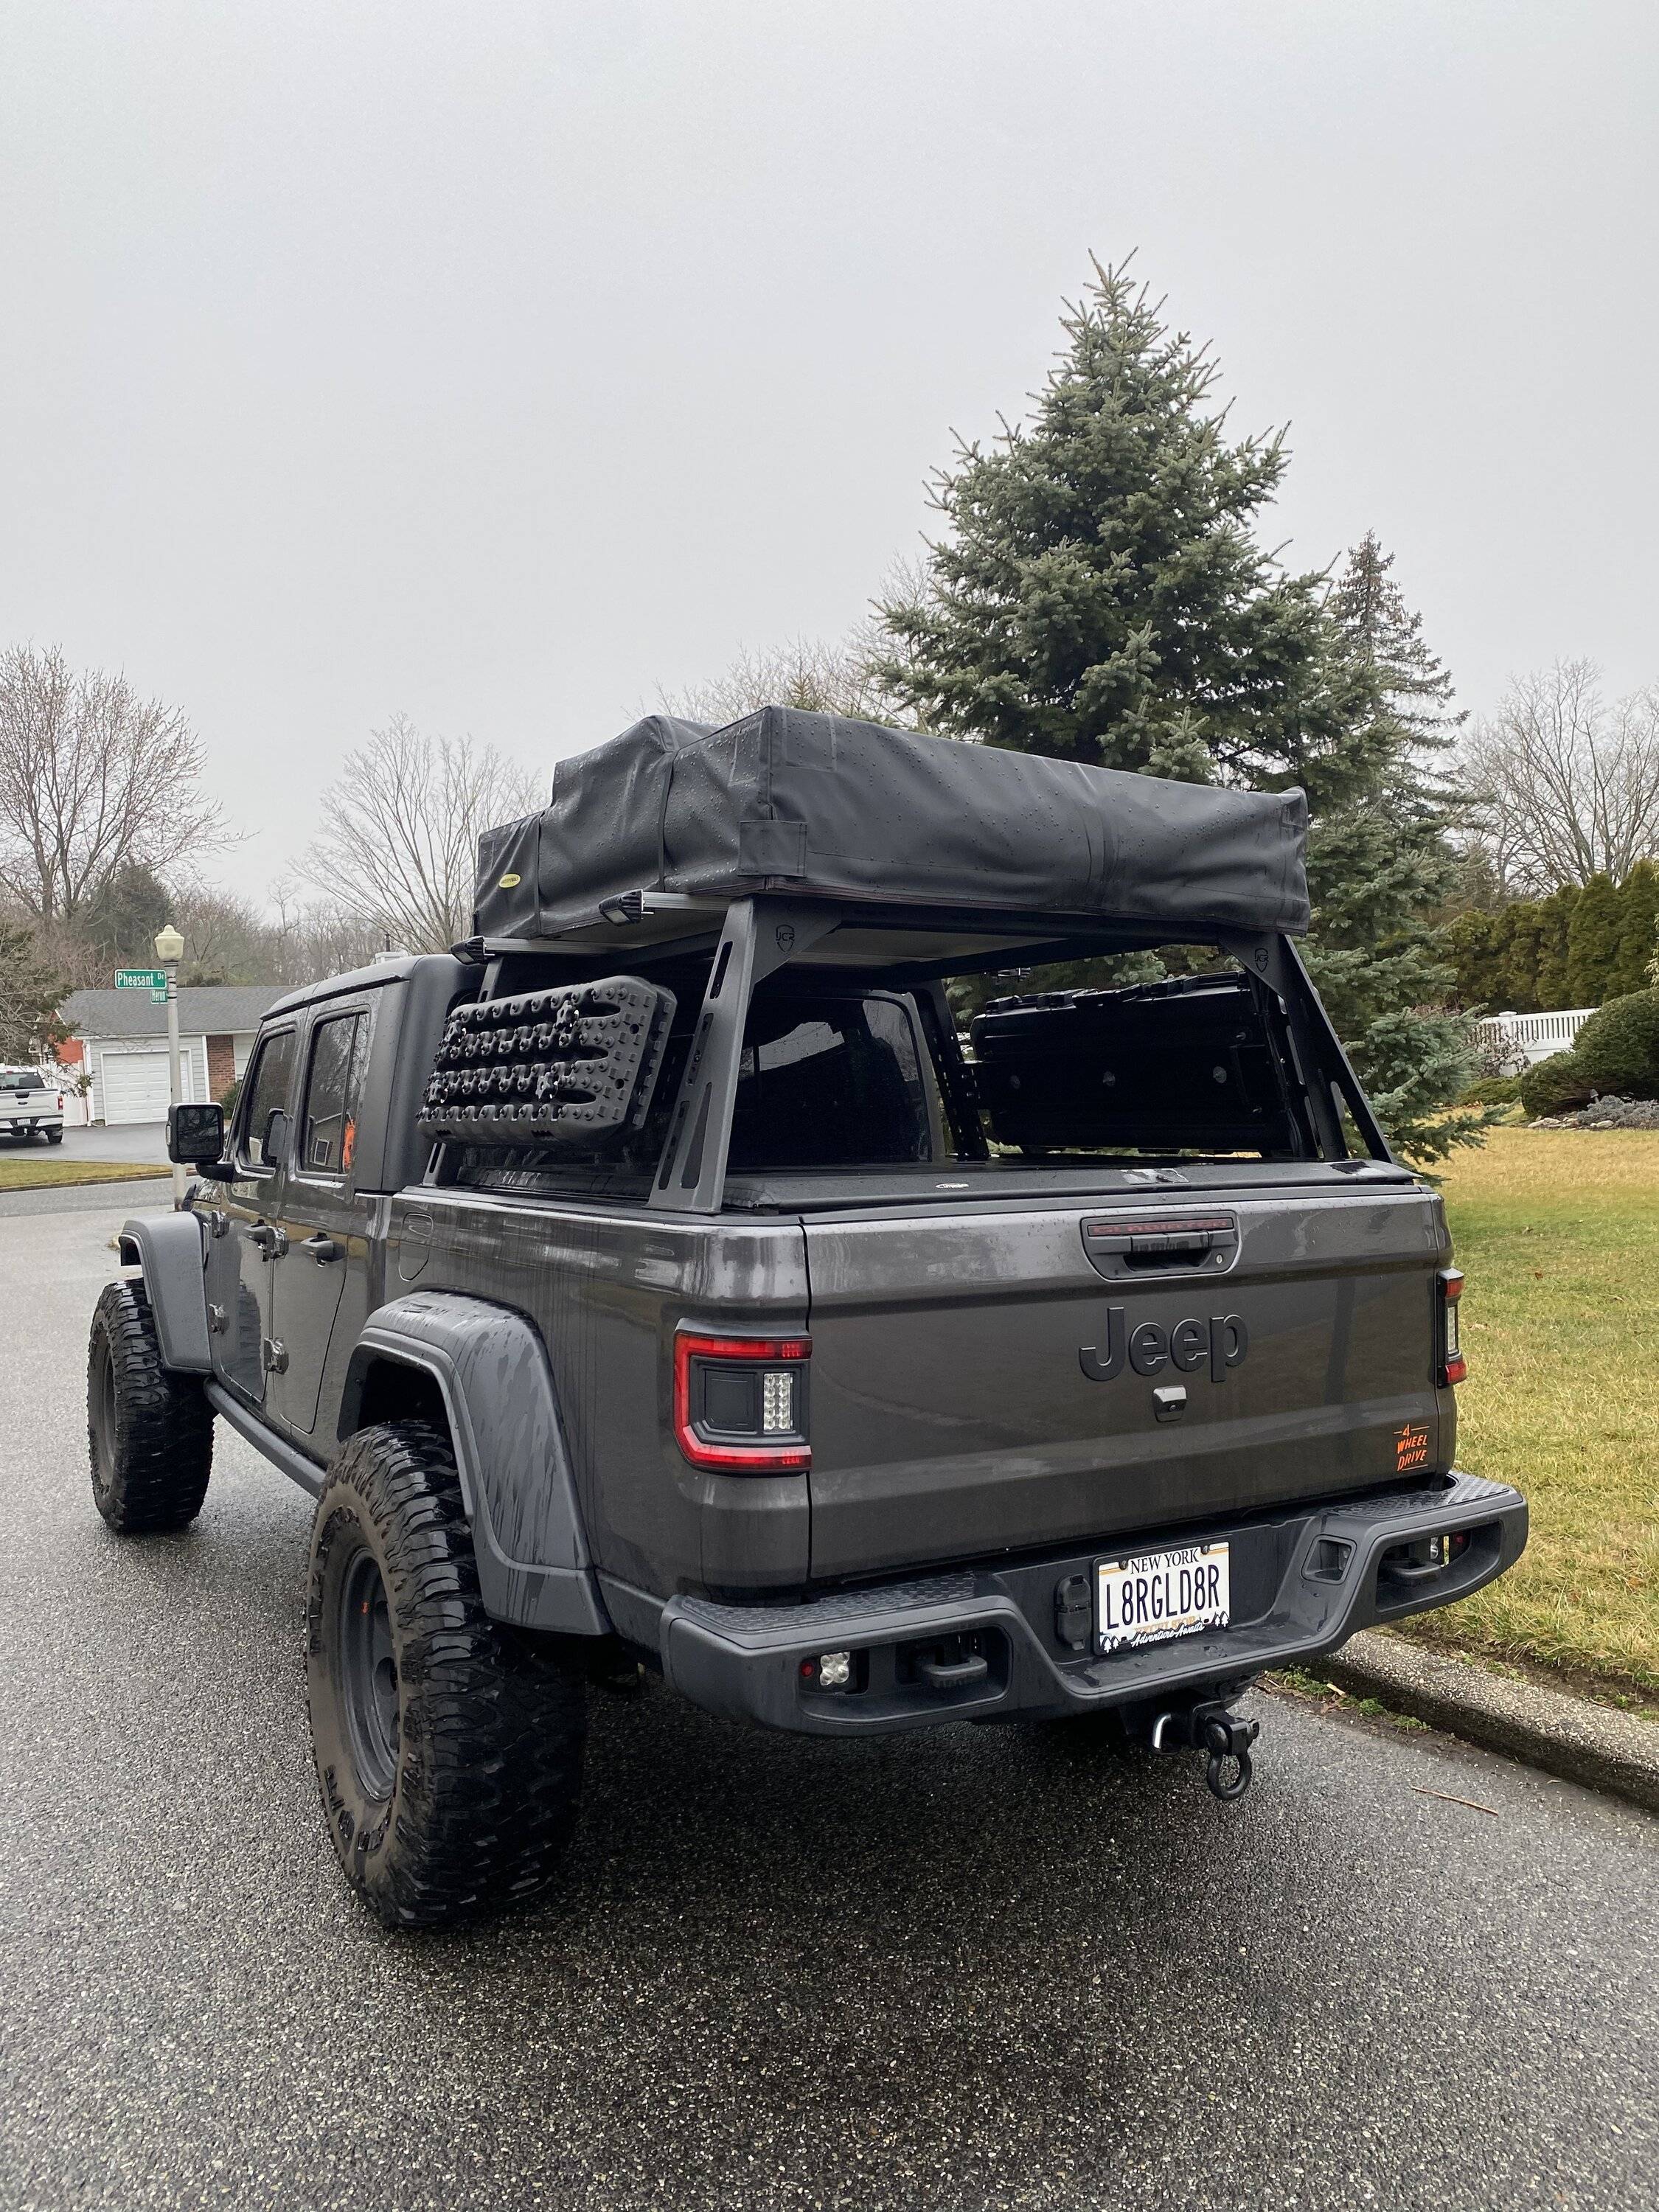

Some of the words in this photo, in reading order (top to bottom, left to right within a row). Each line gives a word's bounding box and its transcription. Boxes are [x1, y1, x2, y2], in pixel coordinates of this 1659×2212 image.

[776, 932, 795, 941] JCR
[117, 972, 154, 987] Pheasant
[1079, 1306, 1248, 1382] Jeep
[1402, 1424, 1410, 1436] 4
[1397, 1434, 1427, 1454] WHEEL
[1397, 1450, 1427, 1471] DRIVE
[1131, 1555, 1161, 1574] NEW
[1164, 1548, 1200, 1568] YORK
[1106, 1564, 1220, 1630] L8RGLD8R
[1130, 1629, 1175, 1647] Adventure
[1175, 1621, 1205, 1638] Awaits
